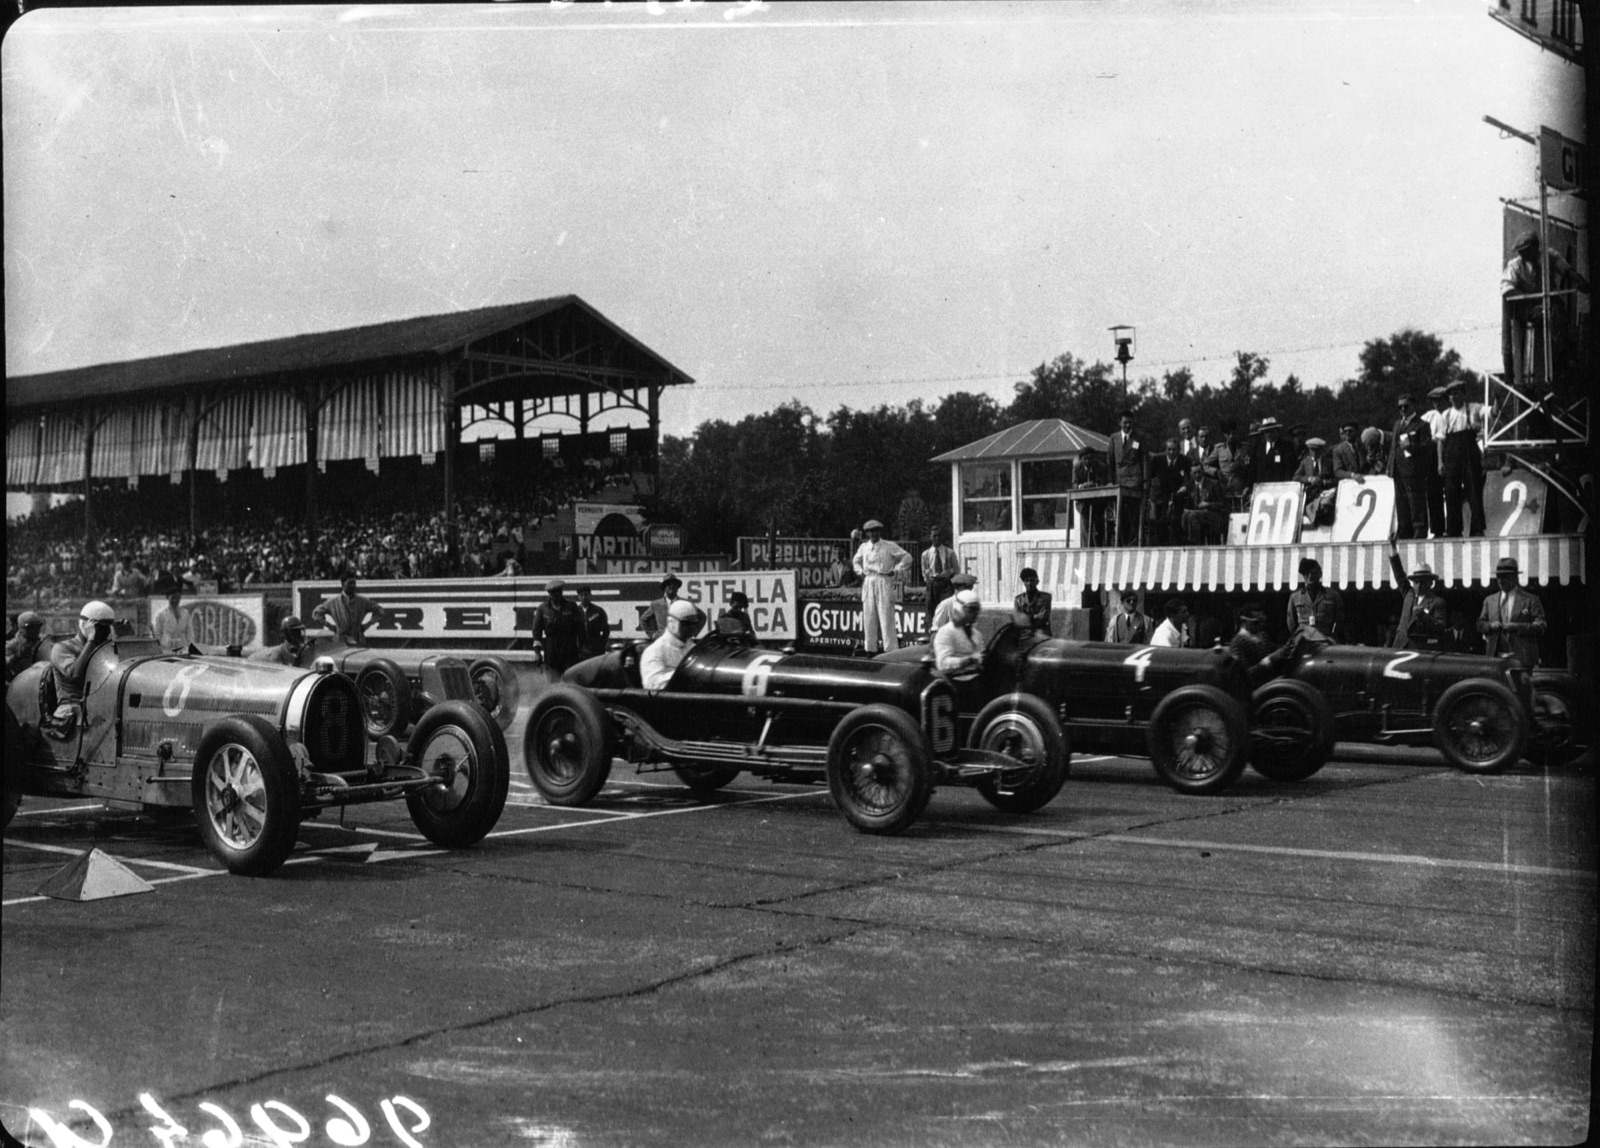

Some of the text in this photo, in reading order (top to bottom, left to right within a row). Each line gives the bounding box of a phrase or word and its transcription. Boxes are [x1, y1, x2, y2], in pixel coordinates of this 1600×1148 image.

[1247, 492, 1299, 545] 60
[1351, 488, 1378, 542] 2
[1500, 480, 1528, 537] 2
[687, 578, 787, 604] STELLA
[803, 602, 926, 638] COSTUM ANE
[809, 637, 851, 646] APERITIVO
[742, 653, 785, 697] 6
[1123, 647, 1156, 682] 4
[1383, 651, 1420, 679] 2
[931, 695, 955, 752] 6
